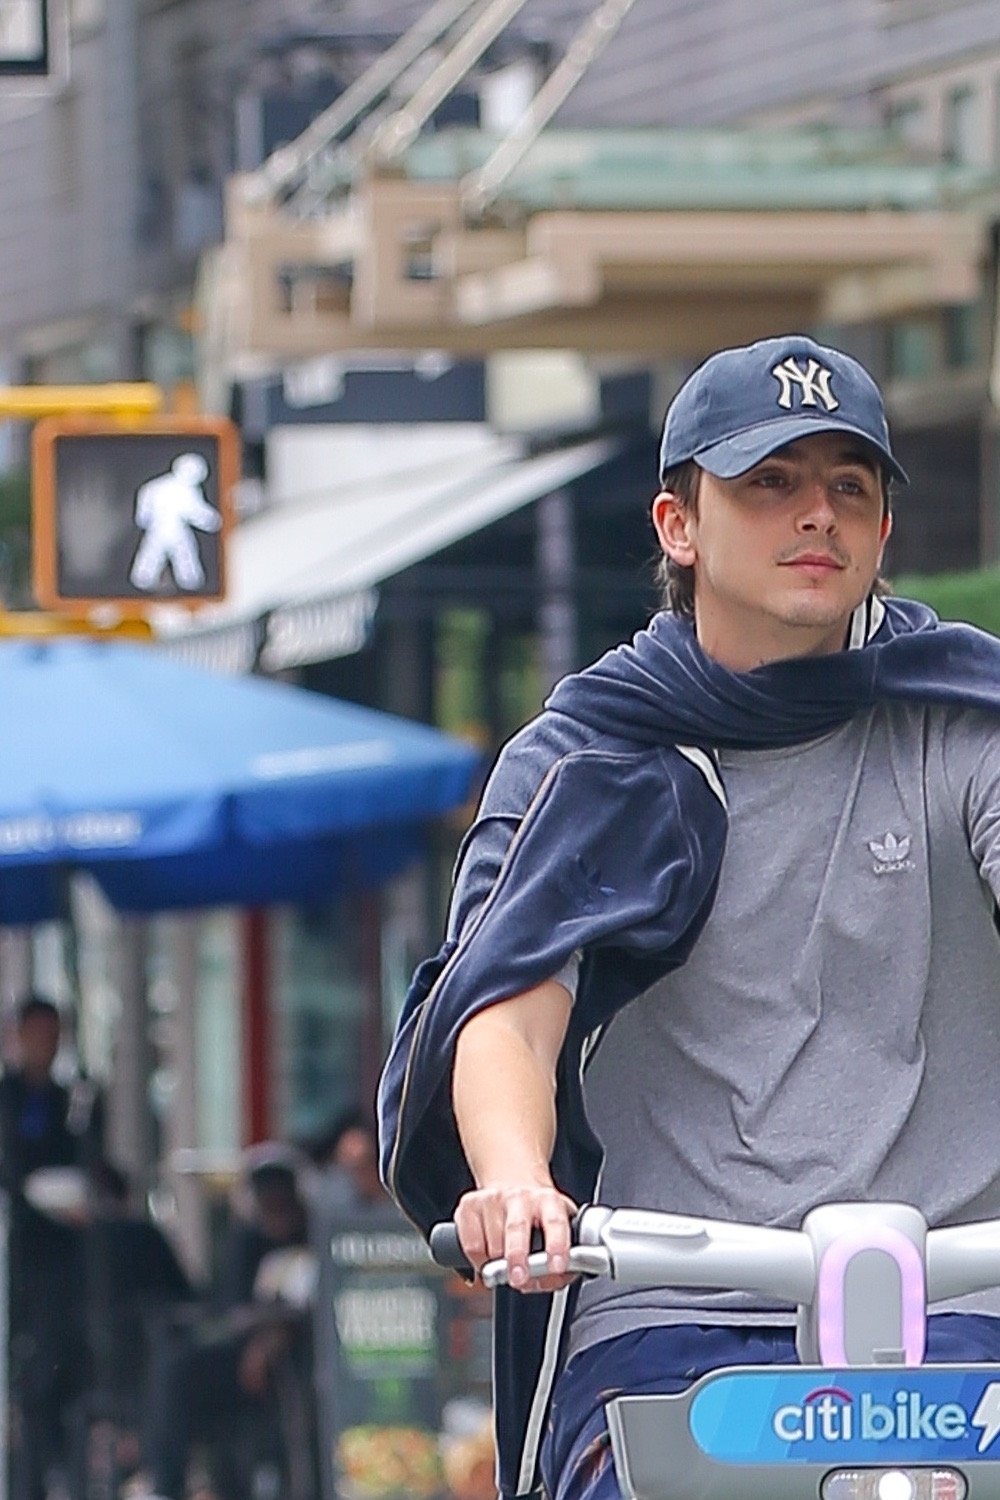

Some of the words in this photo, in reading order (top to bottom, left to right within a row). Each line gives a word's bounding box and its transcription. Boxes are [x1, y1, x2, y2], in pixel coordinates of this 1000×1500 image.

[772, 357, 839, 412] NY
[773, 1387, 853, 1441] citi
[861, 1390, 969, 1440] bike
